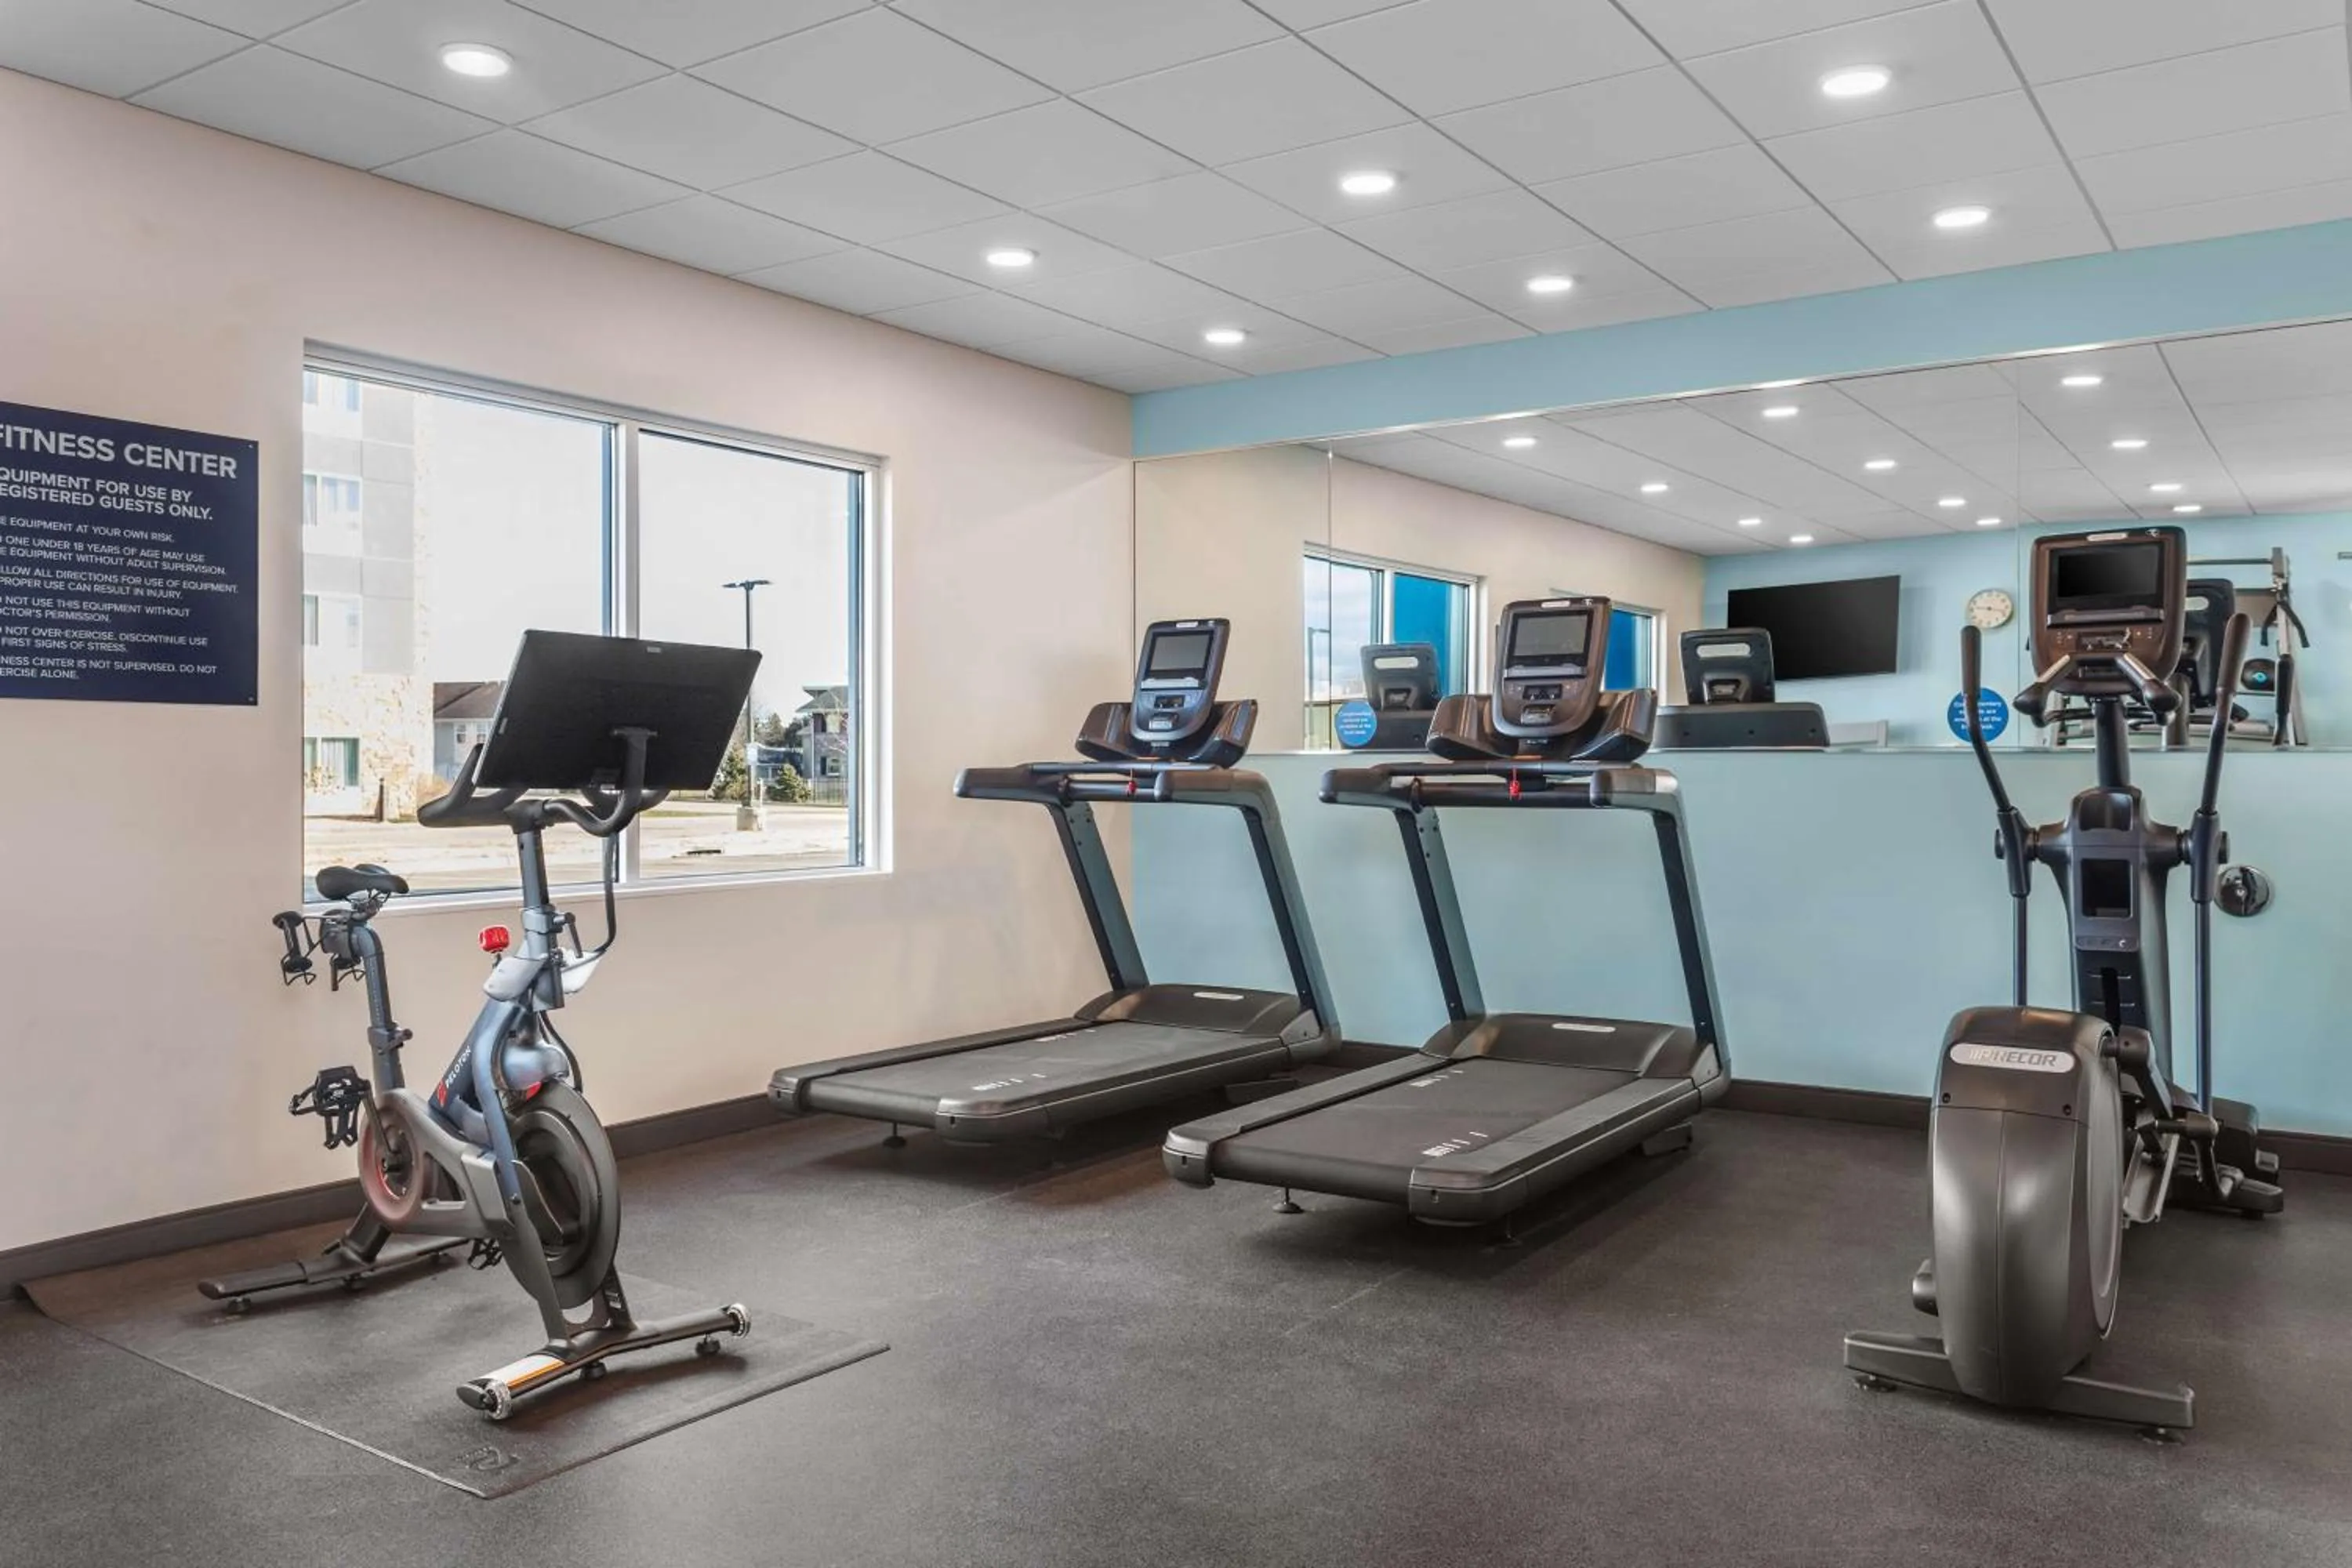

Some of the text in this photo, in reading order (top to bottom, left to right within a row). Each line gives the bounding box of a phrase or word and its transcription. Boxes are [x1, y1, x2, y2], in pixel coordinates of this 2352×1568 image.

[0, 423, 238, 479] ITNESS CENTER
[0, 466, 194, 503] QUIPMENT FOR USE BY
[0, 482, 213, 521] EGISTERED GUESTS ONLY.
[10, 517, 73, 532] EQUIPMENT
[76, 524, 89, 533] AT
[92, 526, 122, 537] YOUR
[123, 529, 148, 539] OWN
[5, 535, 30, 546] ONE
[32, 539, 70, 550] UNDER
[74, 542, 84, 551] 18
[87, 543, 121, 554] YEARS
[123, 546, 137, 556] OF
[140, 549, 161, 559] AGE
[162, 551, 184, 561] MAY
[186, 553, 205, 563] USE
[9, 546, 73, 561] EQUIPMENT
[76, 554, 124, 565] WITHOUT
[126, 558, 159, 568] ADULT
[0, 564, 31, 575] LLOW
[34, 567, 53, 578] ALL
[56, 570, 119, 584] DIRECTIONS
[121, 575, 142, 585] FOR
[143, 577, 164, 587] USE
[166, 579, 181, 588] OF
[43, 580, 65, 590] USE
[67, 582, 92, 593] CAN
[93, 584, 130, 596] RESULT
[133, 587, 144, 597] IN
[5, 595, 28, 605] NOT
[32, 597, 54, 608] USE
[56, 599, 81, 609] THIS
[82, 601, 142, 613] EQUIPMENT
[144, 605, 190, 618] WITHOUT
[1, 637, 31, 647] FIRST
[34, 639, 67, 650] SIGNS
[70, 641, 85, 650] OF
[5, 626, 29, 636] NOT
[118, 633, 187, 645] DISCONTINUE
[189, 637, 208, 647] USE
[0, 655, 30, 666] NESS
[32, 657, 75, 668] CENTER
[77, 659, 88, 670] IS
[89, 659, 111, 670] NOT
[180, 664, 194, 673] DO
[197, 665, 217, 674] NOT
[0, 667, 39, 678] ERCISE
